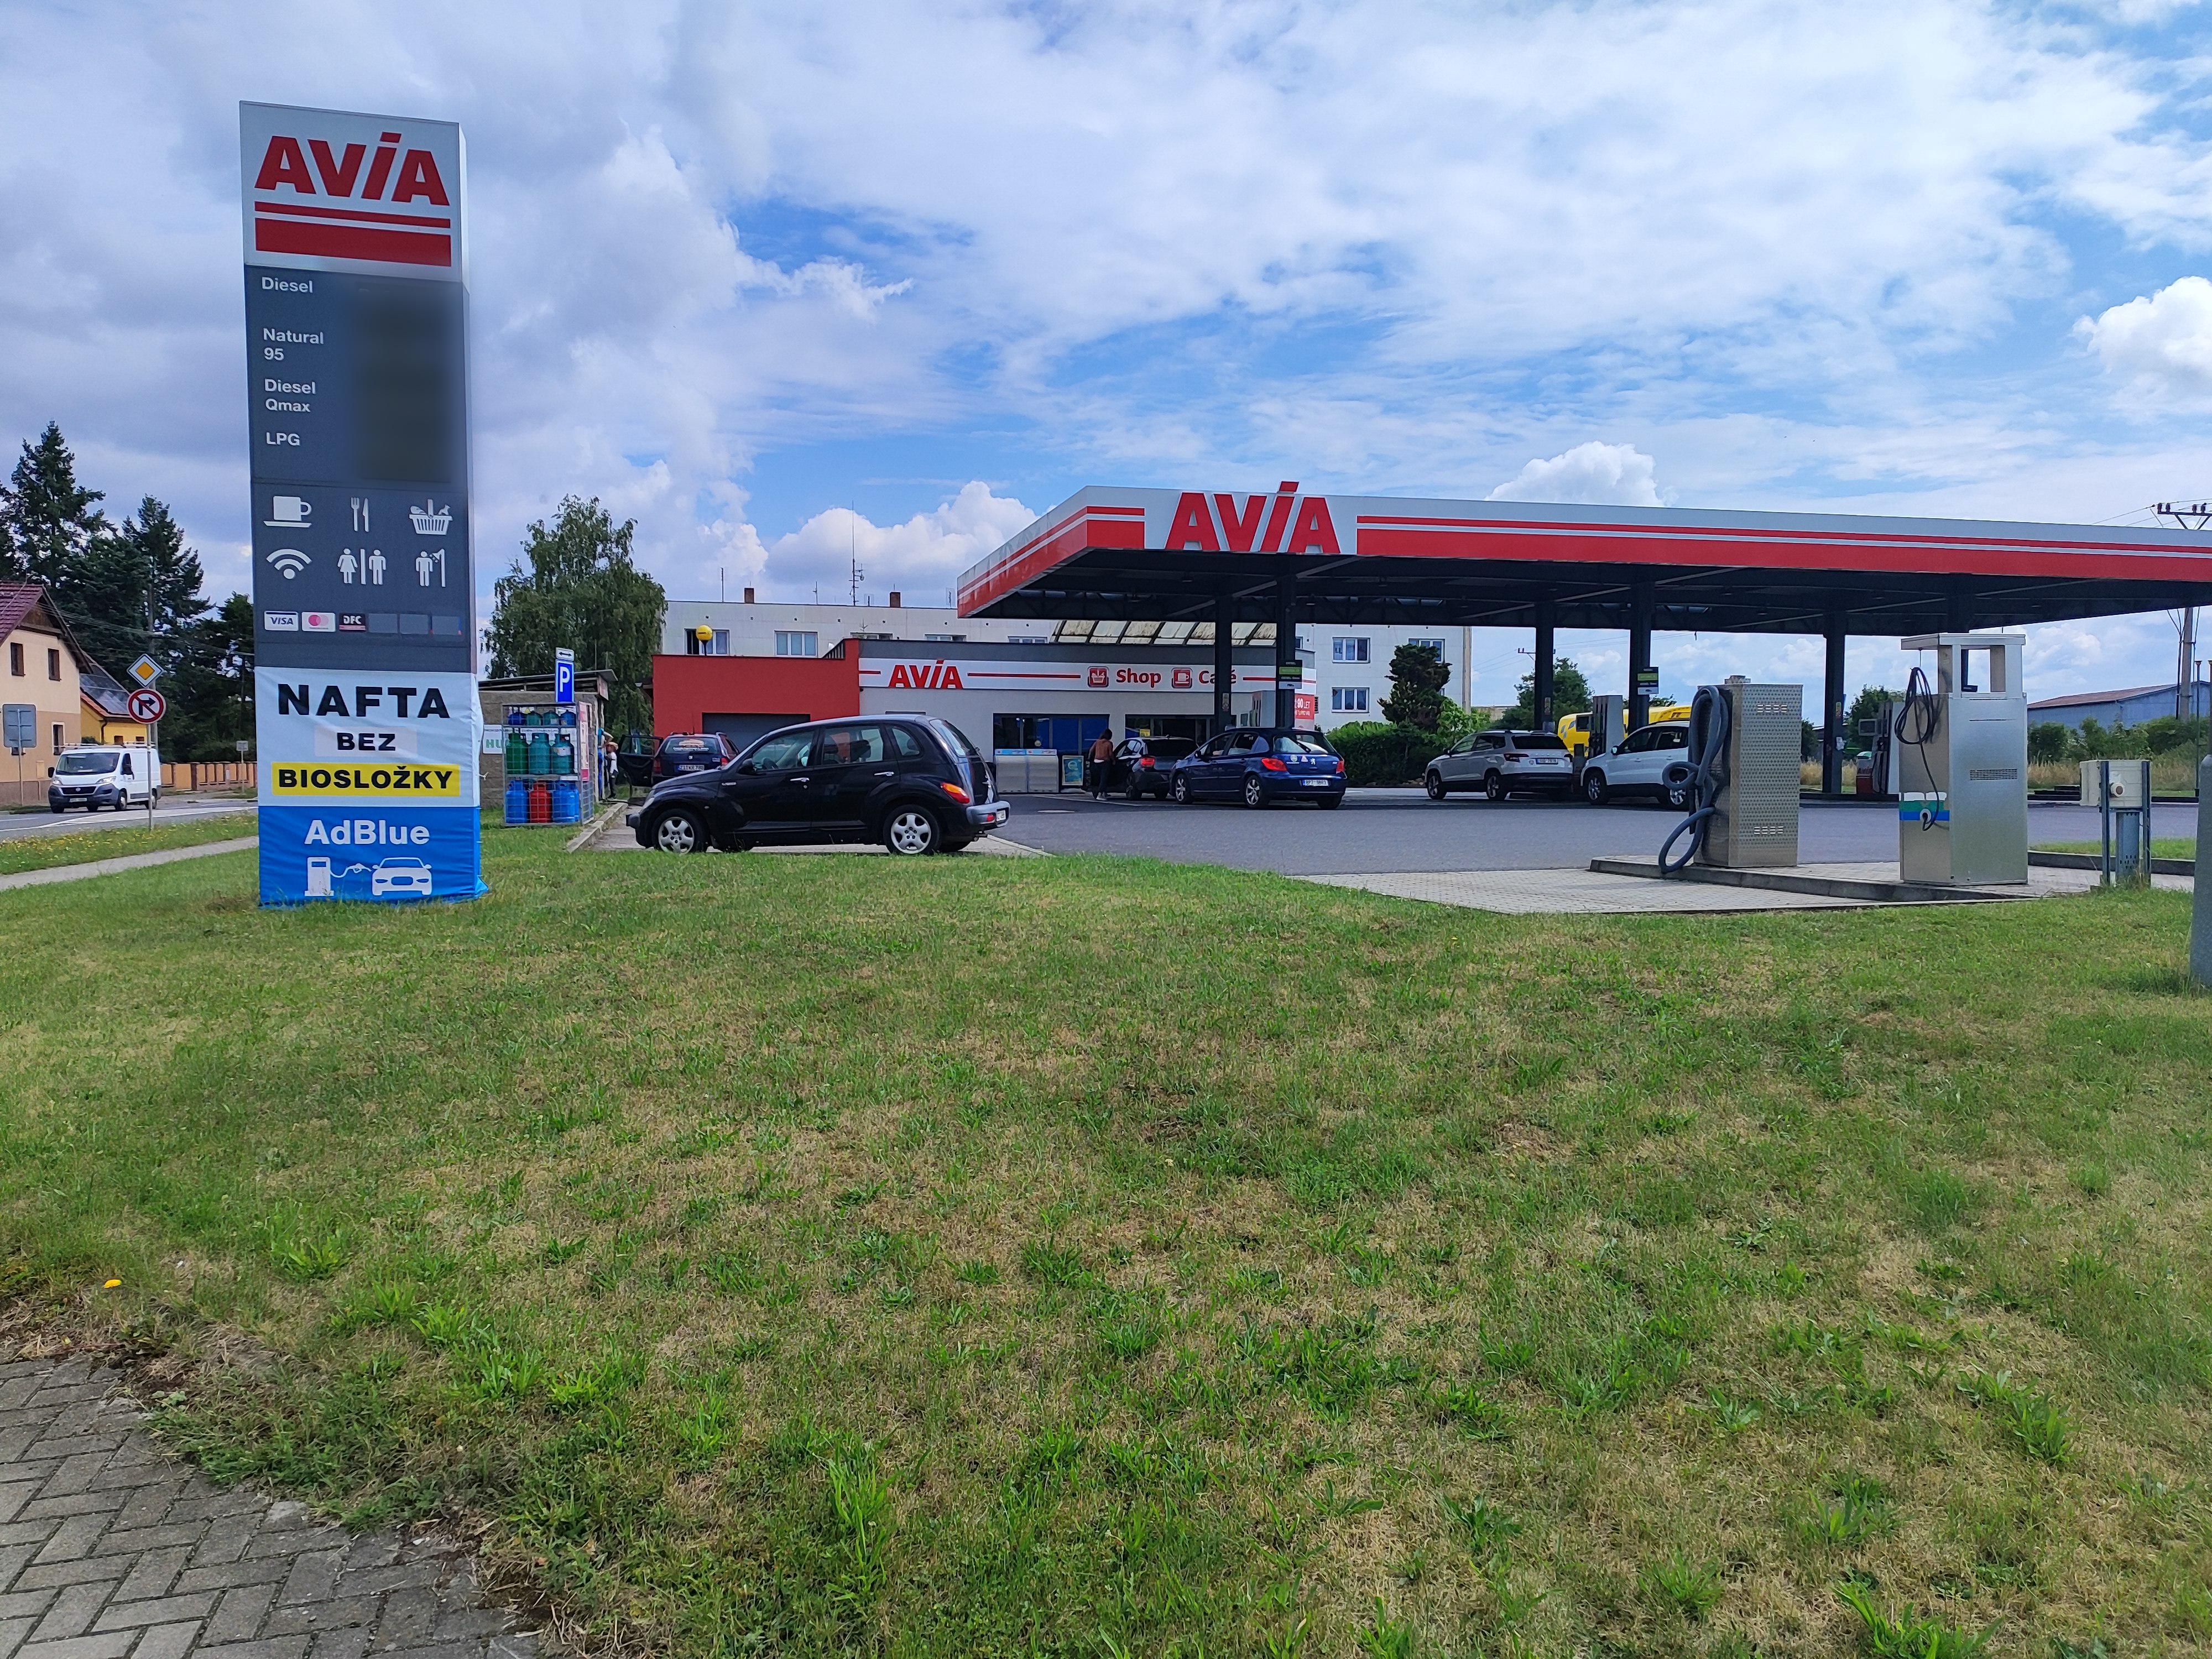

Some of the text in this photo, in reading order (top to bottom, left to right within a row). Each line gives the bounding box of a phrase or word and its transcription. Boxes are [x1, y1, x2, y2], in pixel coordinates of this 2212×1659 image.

[261, 276, 313, 294] Diesel
[263, 328, 324, 345] Natural
[263, 348, 285, 361] 95
[264, 378, 316, 395] Diesel
[265, 398, 311, 413] Qmax
[265, 431, 300, 446] LPG
[270, 617, 294, 625] VISA
[343, 615, 362, 625] DFC
[560, 666, 570, 692] P
[1116, 668, 1237, 688] Shop Caé
[278, 684, 450, 718] NAFTA
[337, 733, 396, 751] BEZ
[278, 766, 452, 789] BIOSLOŽKY
[304, 820, 430, 845] AdBlue
